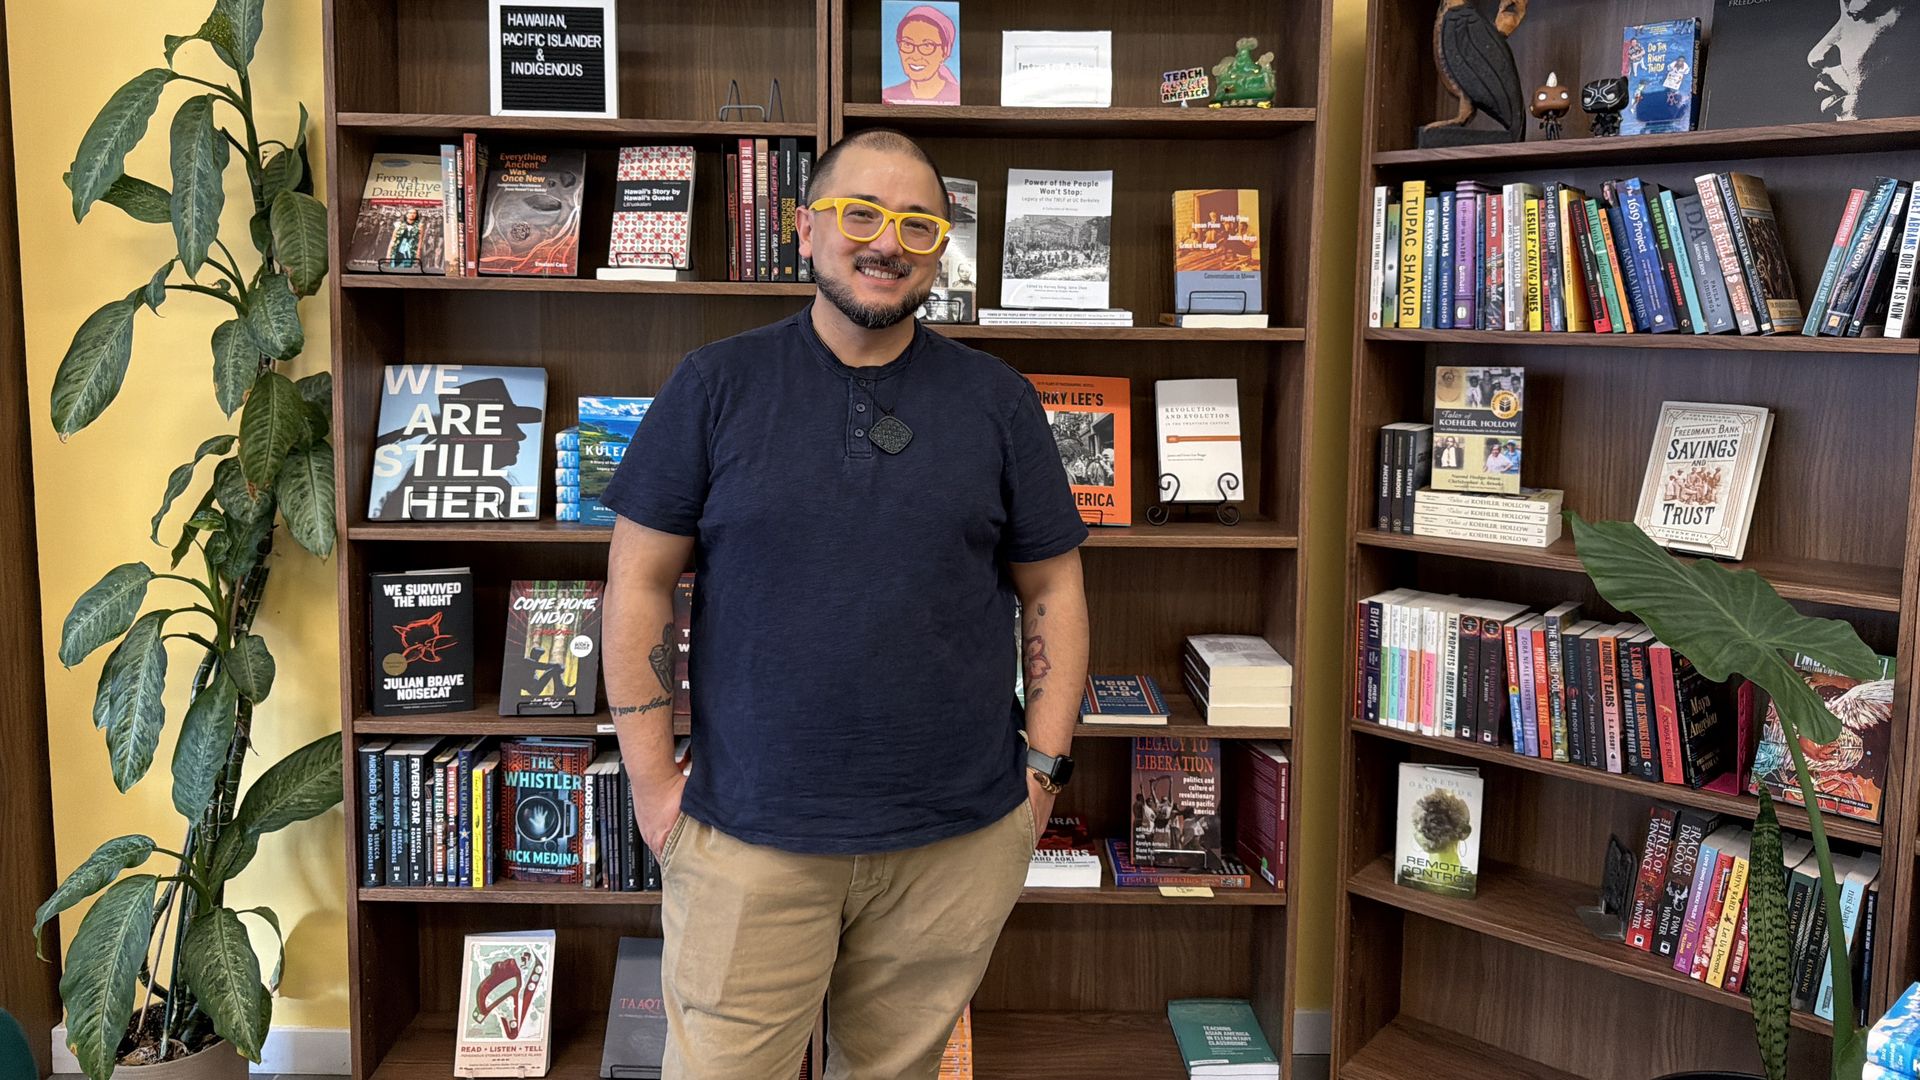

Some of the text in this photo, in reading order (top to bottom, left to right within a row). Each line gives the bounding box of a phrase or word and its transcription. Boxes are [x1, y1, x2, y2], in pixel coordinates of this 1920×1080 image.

[508, 13, 567, 29] HAWAIIAN,
[503, 33, 602, 48] PACIFIC ISLANDER
[536, 48, 545, 61] &
[511, 62, 583, 76] INDIGENOUS
[1165, 69, 1202, 82] TEACH
[1163, 89, 1208, 100] AMERICA
[500, 153, 547, 163] Everything
[504, 161, 539, 169] Ancient
[375, 173, 408, 183] From
[501, 174, 545, 183] Once New
[510, 168, 526, 176] Was
[742, 160, 752, 204] DAWNHOUNDS
[372, 187, 432, 199] Daughter
[396, 180, 441, 191] Native
[1073, 180, 1099, 188] People
[1546, 185, 1555, 219] Soledad
[1441, 196, 1450, 257] WHO ALWAYS WAS
[1526, 207, 1536, 236] LESLIE
[1626, 198, 1648, 253] 1619 Project
[1650, 198, 1670, 250] TEACH TRUTH
[1683, 201, 1708, 242] IDA
[1699, 181, 1730, 272] RISE OF KILLAH
[1851, 184, 1887, 270] THE NEW JIM CROW
[1426, 209, 1435, 257] RAEKWON
[1547, 222, 1557, 254] Brother
[1903, 217, 1920, 250] ABRAMS
[1402, 196, 1419, 316] TUPAC SHAKUR
[1899, 253, 1914, 269] OUR
[1513, 250, 1521, 288] OUTSIDER
[1621, 248, 1637, 285] KAMALA
[1631, 285, 1647, 318] HARRIS
[1895, 271, 1911, 290] TIME
[1529, 282, 1539, 312] JONES
[1894, 292, 1907, 300] IS
[1889, 301, 1904, 320] NOW
[384, 364, 462, 395] WE
[1071, 392, 1104, 406] LEE'S
[403, 403, 504, 435] ARE
[1439, 419, 1518, 428] KOEHLER HOLLOW
[1718, 424, 1740, 434] BANK
[373, 443, 508, 477] STILL
[1667, 439, 1738, 460] SAVINGS
[1381, 464, 1389, 498] ANCESTORS
[401, 485, 538, 519] HERE
[1662, 503, 1716, 525] TRUST
[383, 582, 462, 597] WE SURVIVED
[392, 594, 452, 608] THE NIGHT
[513, 597, 598, 612] COME HOME,
[530, 612, 575, 625] INDIO
[1369, 607, 1379, 639] BINTI
[1446, 617, 1457, 697] THE PROPHETS ROBERT
[1547, 624, 1561, 694] THE WISHING POOL
[383, 674, 464, 690] JULIAN BRAVE
[1521, 636, 1531, 711] ZORA NEALE HURSTON
[397, 687, 452, 701] NOISECAT
[1604, 679, 1615, 707] TEARS
[1634, 692, 1647, 715] ALL THE
[1623, 688, 1636, 753] MY DARKEST PRAYER
[1660, 715, 1670, 740] OCTAVIA
[1136, 737, 1209, 752] LEGACY TO
[531, 756, 554, 769] THE
[1135, 755, 1214, 773] LIBERATION
[411, 757, 420, 824] FEVERED STAR
[504, 771, 582, 790] WHISTLER
[1183, 776, 1204, 785] politics
[368, 754, 378, 831] MIRRORED HEAVENS
[392, 760, 400, 827] MIRRORED HEAVENS
[435, 768, 444, 823] BROKEN FIELDS
[1178, 792, 1215, 801] revolutionary
[585, 775, 593, 840] BLOOD SISTERS
[1641, 818, 1660, 871] VENGEANCE
[1652, 823, 1672, 873] FIRES OF
[1671, 824, 1690, 875] DRAGONS
[1682, 830, 1702, 877] RAGE OF
[505, 849, 581, 867] NICK MEDINA
[1406, 856, 1469, 874] REMOTE
[1702, 854, 1710, 867] LOVE
[1401, 865, 1465, 883] CONTRO
[1699, 867, 1707, 881] SONG
[1631, 899, 1645, 929] WINTER
[1642, 908, 1653, 929] EVAN
[1658, 905, 1672, 935] WINTER
[1712, 861, 1745, 974] JESMYN WARD Let Us Descend
[1842, 889, 1856, 929] nisi shawl
[1670, 915, 1681, 936] EVAN
[1800, 916, 1824, 992] SHAWL KINNING
[620, 998, 662, 1013] TAAQT
[489, 1045, 517, 1053] LISTEN
